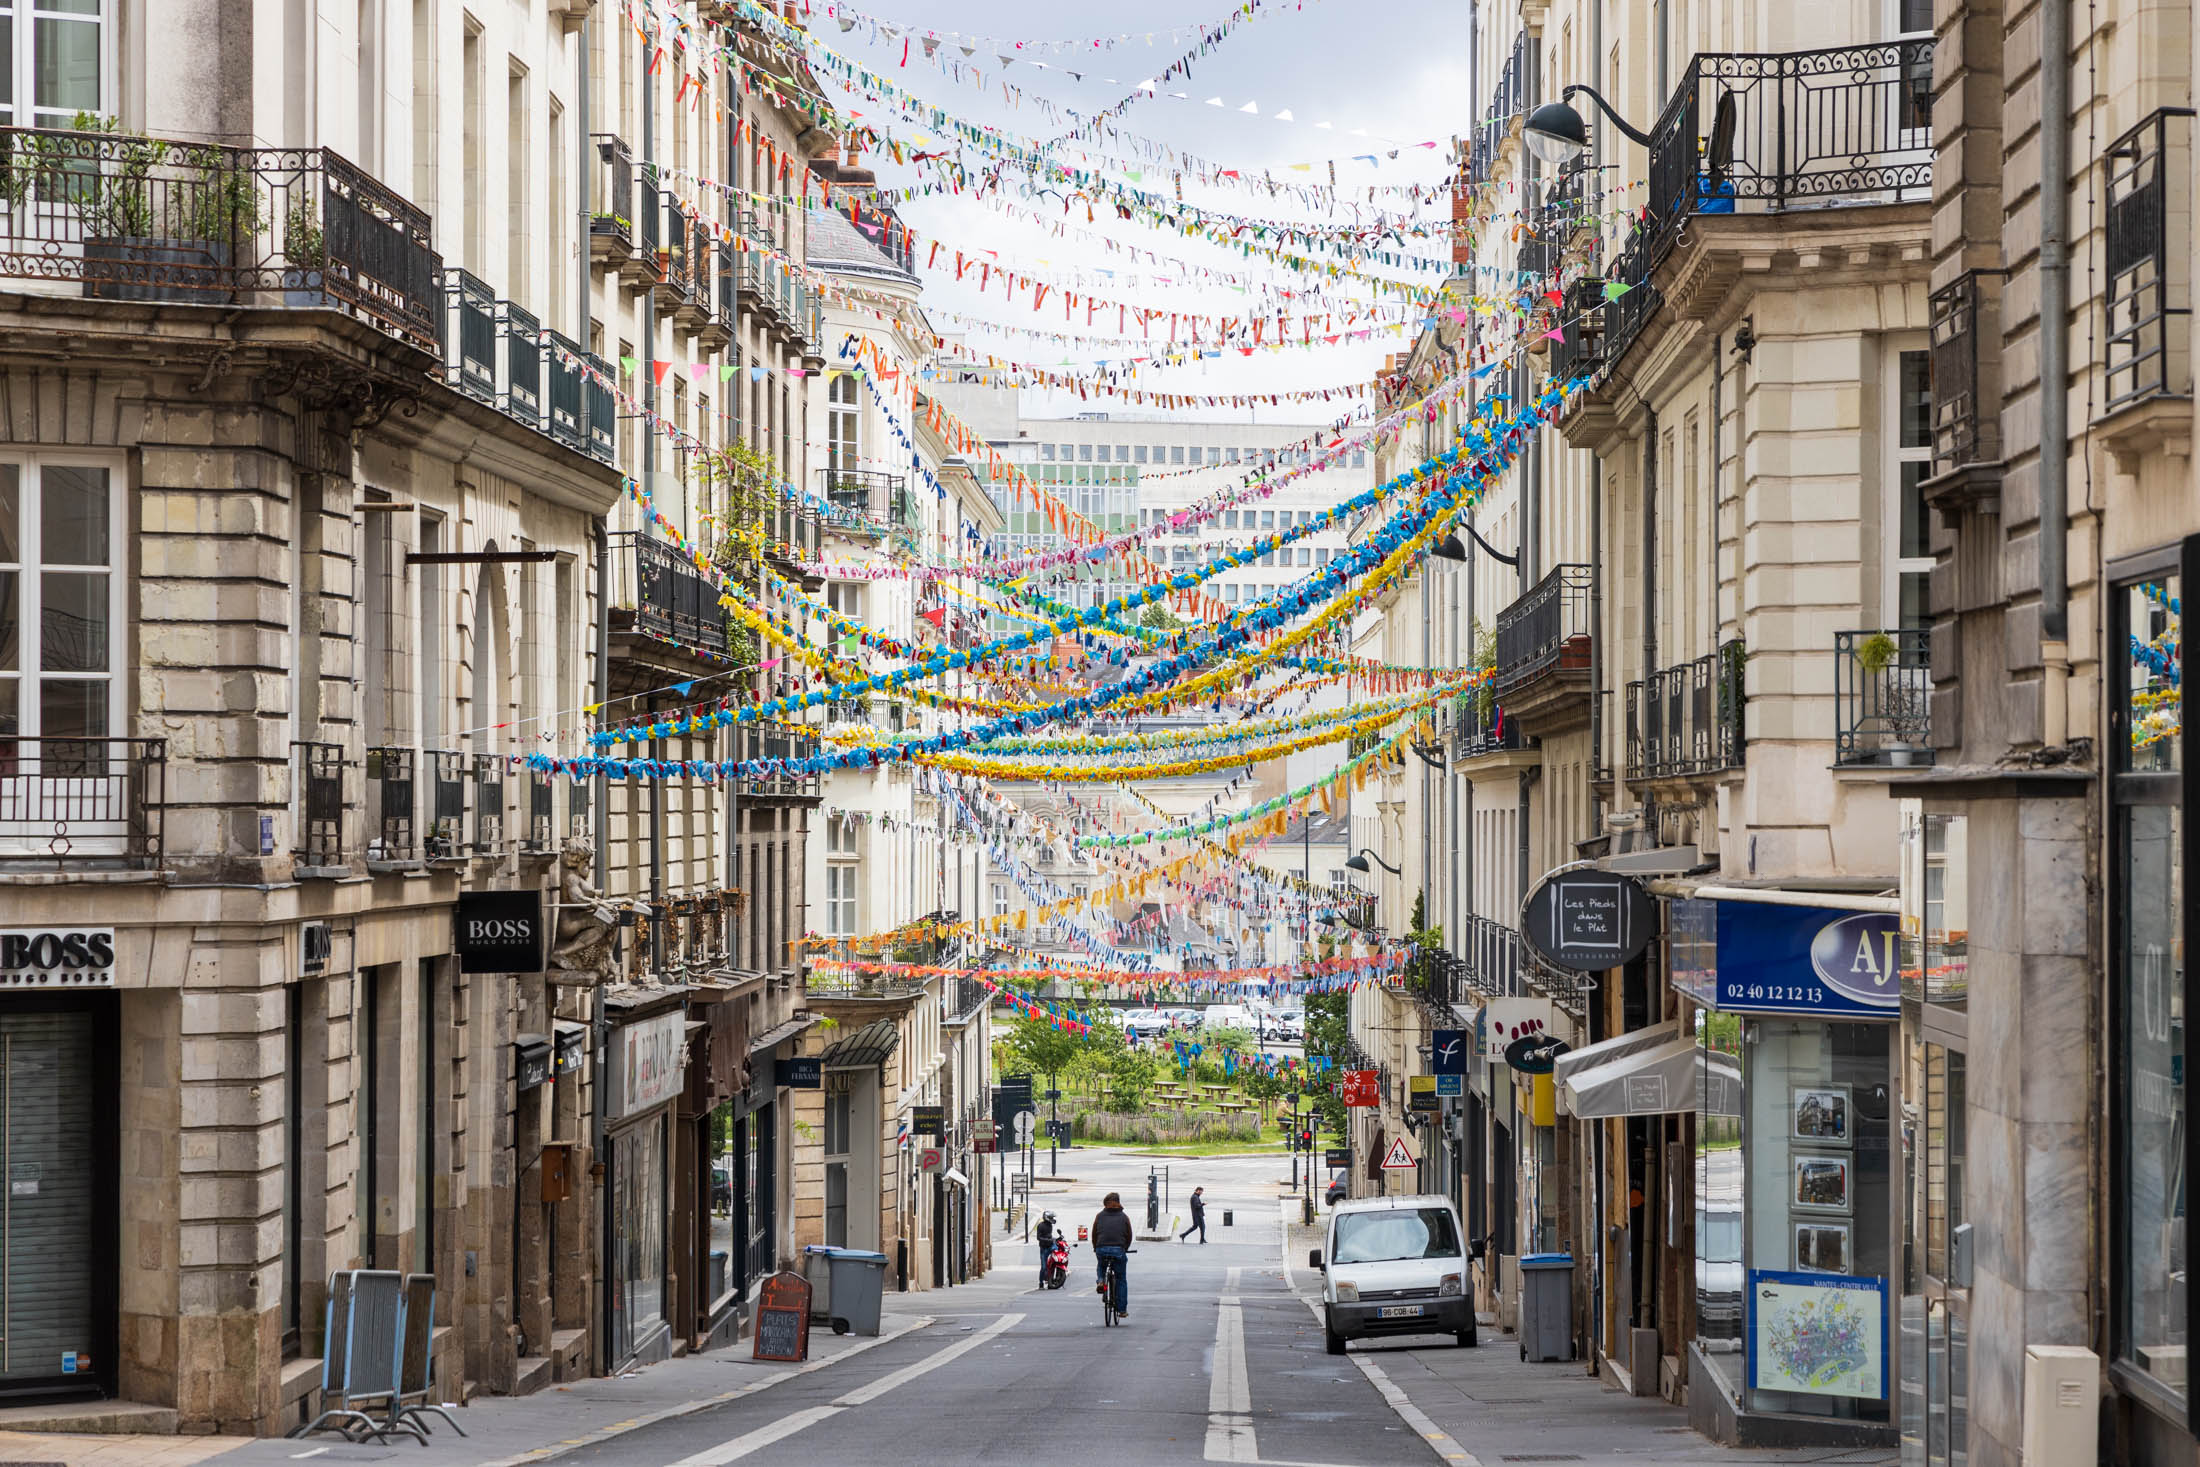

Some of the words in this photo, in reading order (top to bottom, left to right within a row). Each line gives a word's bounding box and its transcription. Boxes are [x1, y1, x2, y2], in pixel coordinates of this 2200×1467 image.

[1564, 898, 1584, 908] Les
[1589, 898, 1616, 908] Pieds
[1577, 911, 1603, 920] dans
[468, 919, 530, 938] BOSS
[1573, 923, 1583, 932] le
[1588, 923, 1607, 932] Plat
[0, 932, 114, 969] BOSS
[1850, 929, 1900, 986] AJ
[0, 974, 48, 984] HUGO
[61, 973, 109, 984] BOSS
[1727, 984, 1744, 998] 02
[1746, 983, 1763, 999] 40
[1767, 985, 1783, 1000] 12
[1787, 986, 1803, 1001] 12
[1807, 987, 1823, 1004] 13
